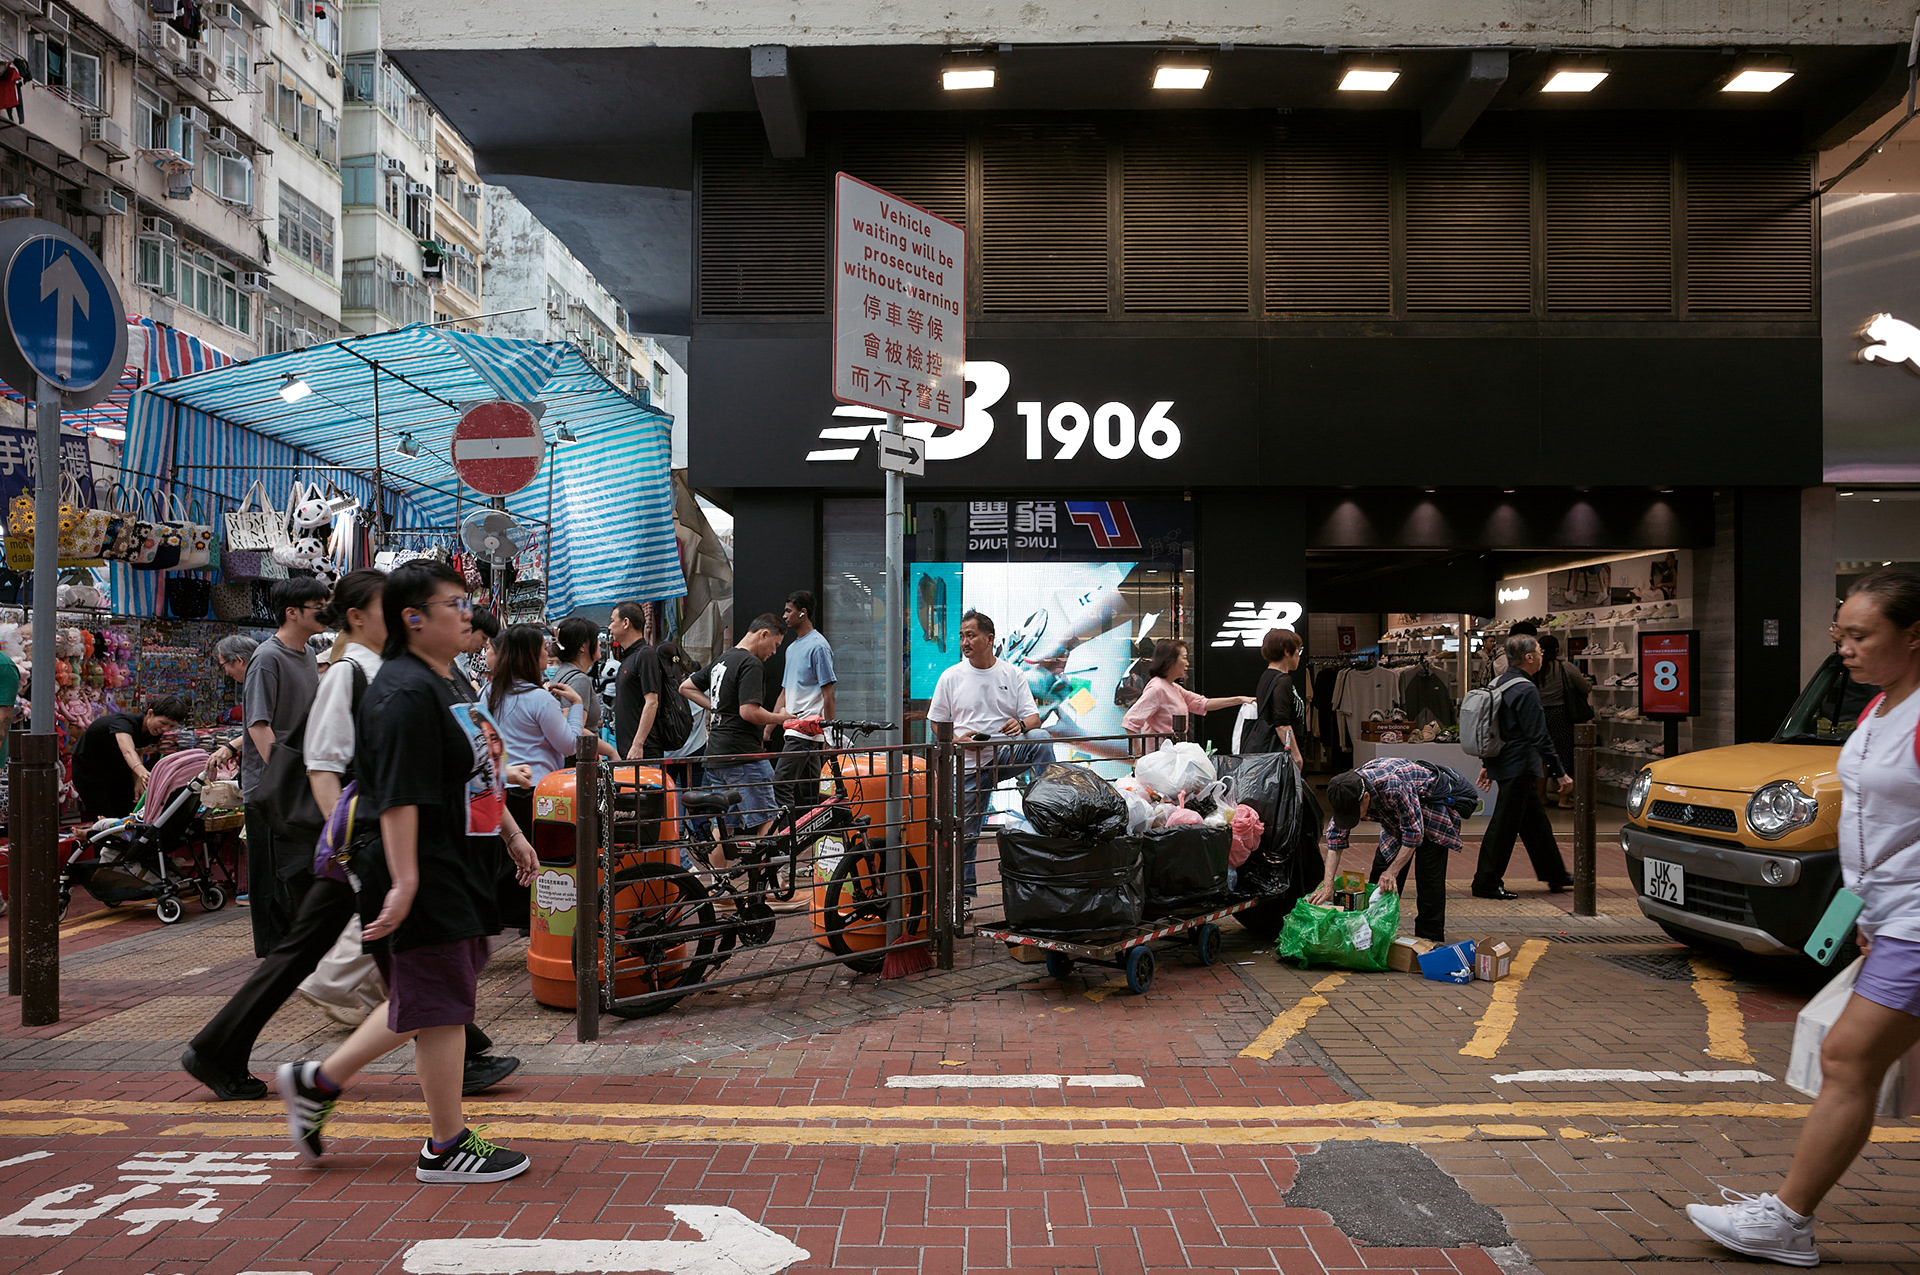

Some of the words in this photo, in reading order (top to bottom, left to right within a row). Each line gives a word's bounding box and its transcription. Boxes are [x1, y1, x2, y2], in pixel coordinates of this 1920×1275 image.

[880, 200, 931, 238] Vehicle
[852, 217, 907, 252] waiting
[911, 241, 935, 262] will
[938, 249, 953, 269] be
[864, 245, 943, 287] prosecuted
[844, 261, 902, 293] without
[906, 284, 959, 316] warning
[863, 293, 943, 343] 停車等候
[863, 332, 943, 378] 會被檢控
[851, 364, 952, 415] 而不予警告
[1016, 400, 1182, 461] 1906
[12, 551, 32, 563] data
[1342, 634, 1352, 646] 8
[1653, 660, 1679, 692] 8
[1650, 877, 1678, 902] 5172
[1654, 861, 1671, 883] UK
